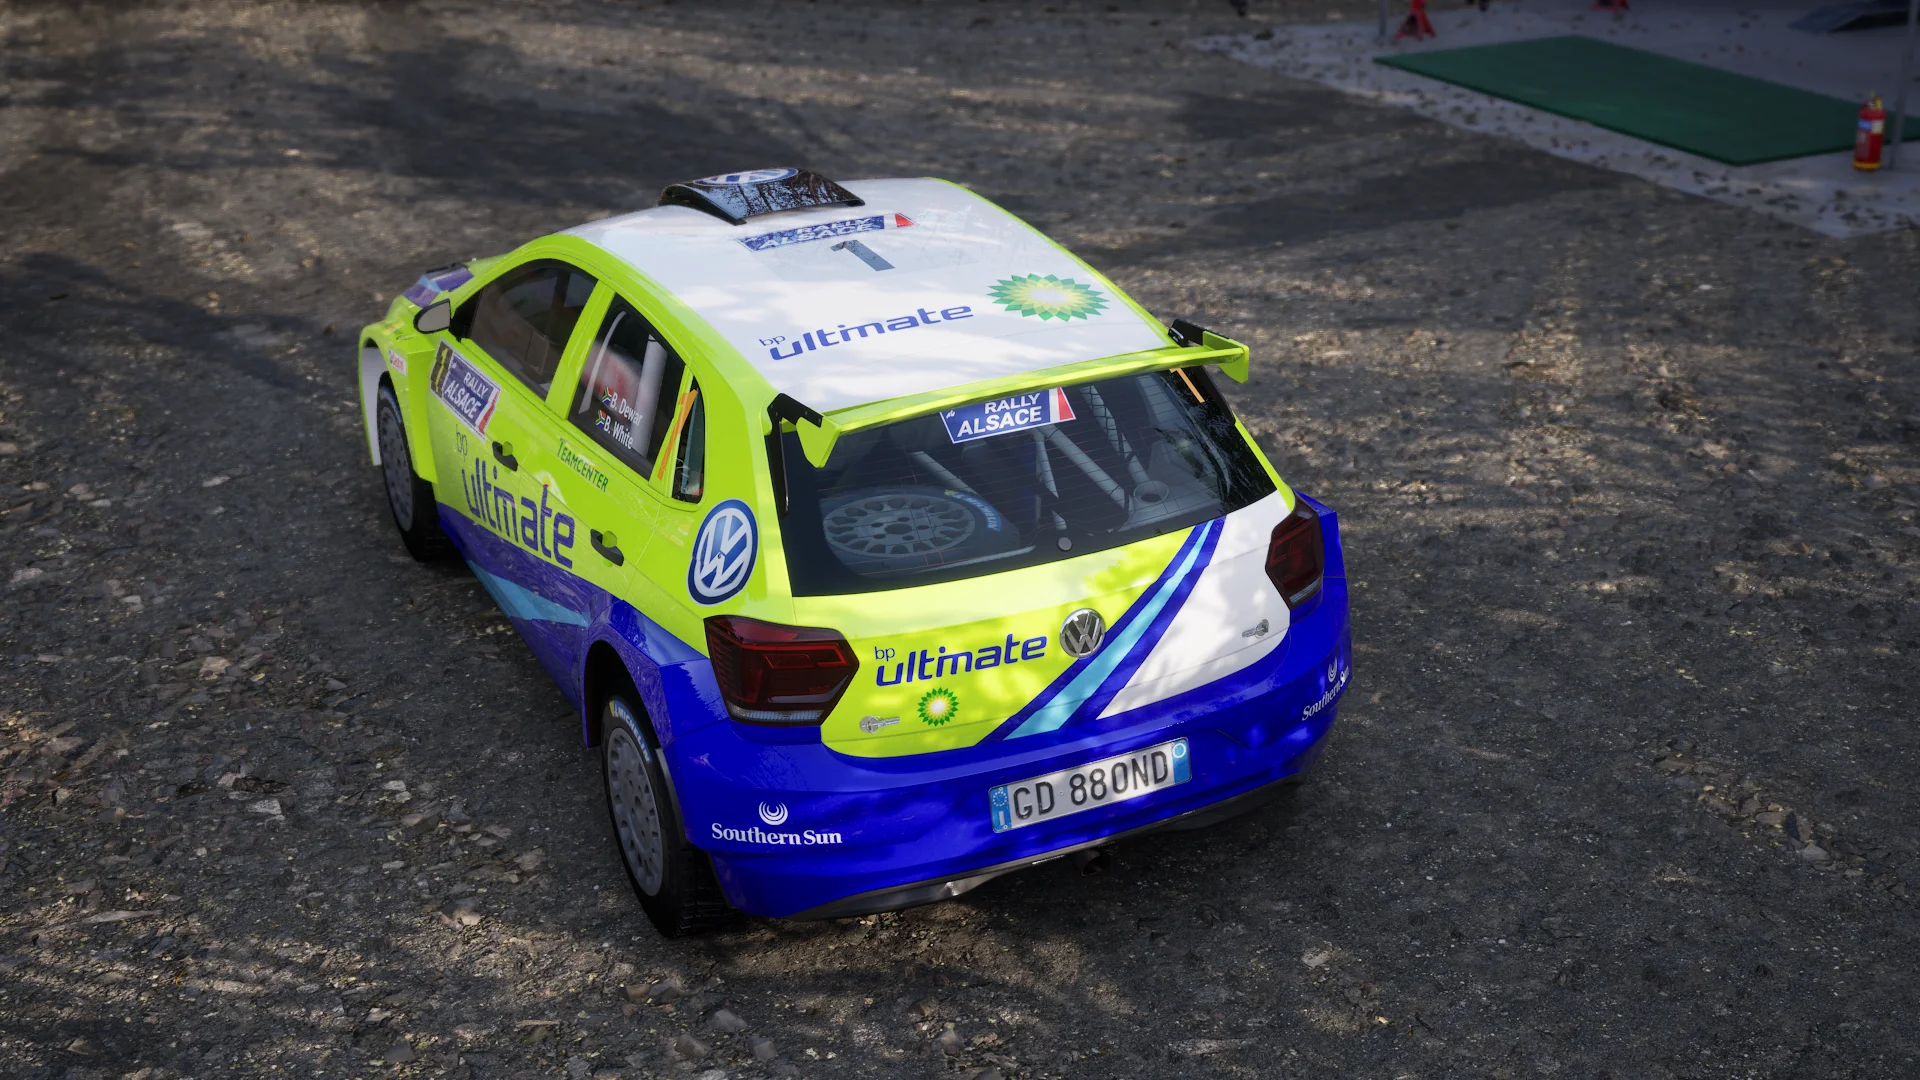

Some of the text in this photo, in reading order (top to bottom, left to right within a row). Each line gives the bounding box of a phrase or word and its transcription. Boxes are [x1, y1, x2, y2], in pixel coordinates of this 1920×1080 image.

[758, 224, 874, 250] ALSACE
[797, 218, 872, 235] RALLY
[830, 240, 895, 271] 1
[759, 335, 786, 348] bp
[769, 305, 974, 361] ultimate
[444, 380, 482, 418] ALSACE
[463, 372, 489, 399] RALLY
[610, 391, 643, 426] B. Dewar
[984, 393, 1041, 414] RALLY
[603, 415, 633, 449] B. White
[957, 406, 1042, 437] ALSACE
[455, 424, 468, 462] bp
[461, 457, 575, 569] ultimate
[874, 646, 896, 662] bp
[876, 633, 1047, 686] ultimate
[1302, 680, 1340, 721] Southern
[1013, 781, 1055, 820] GD
[711, 823, 843, 846] Southern Sun
